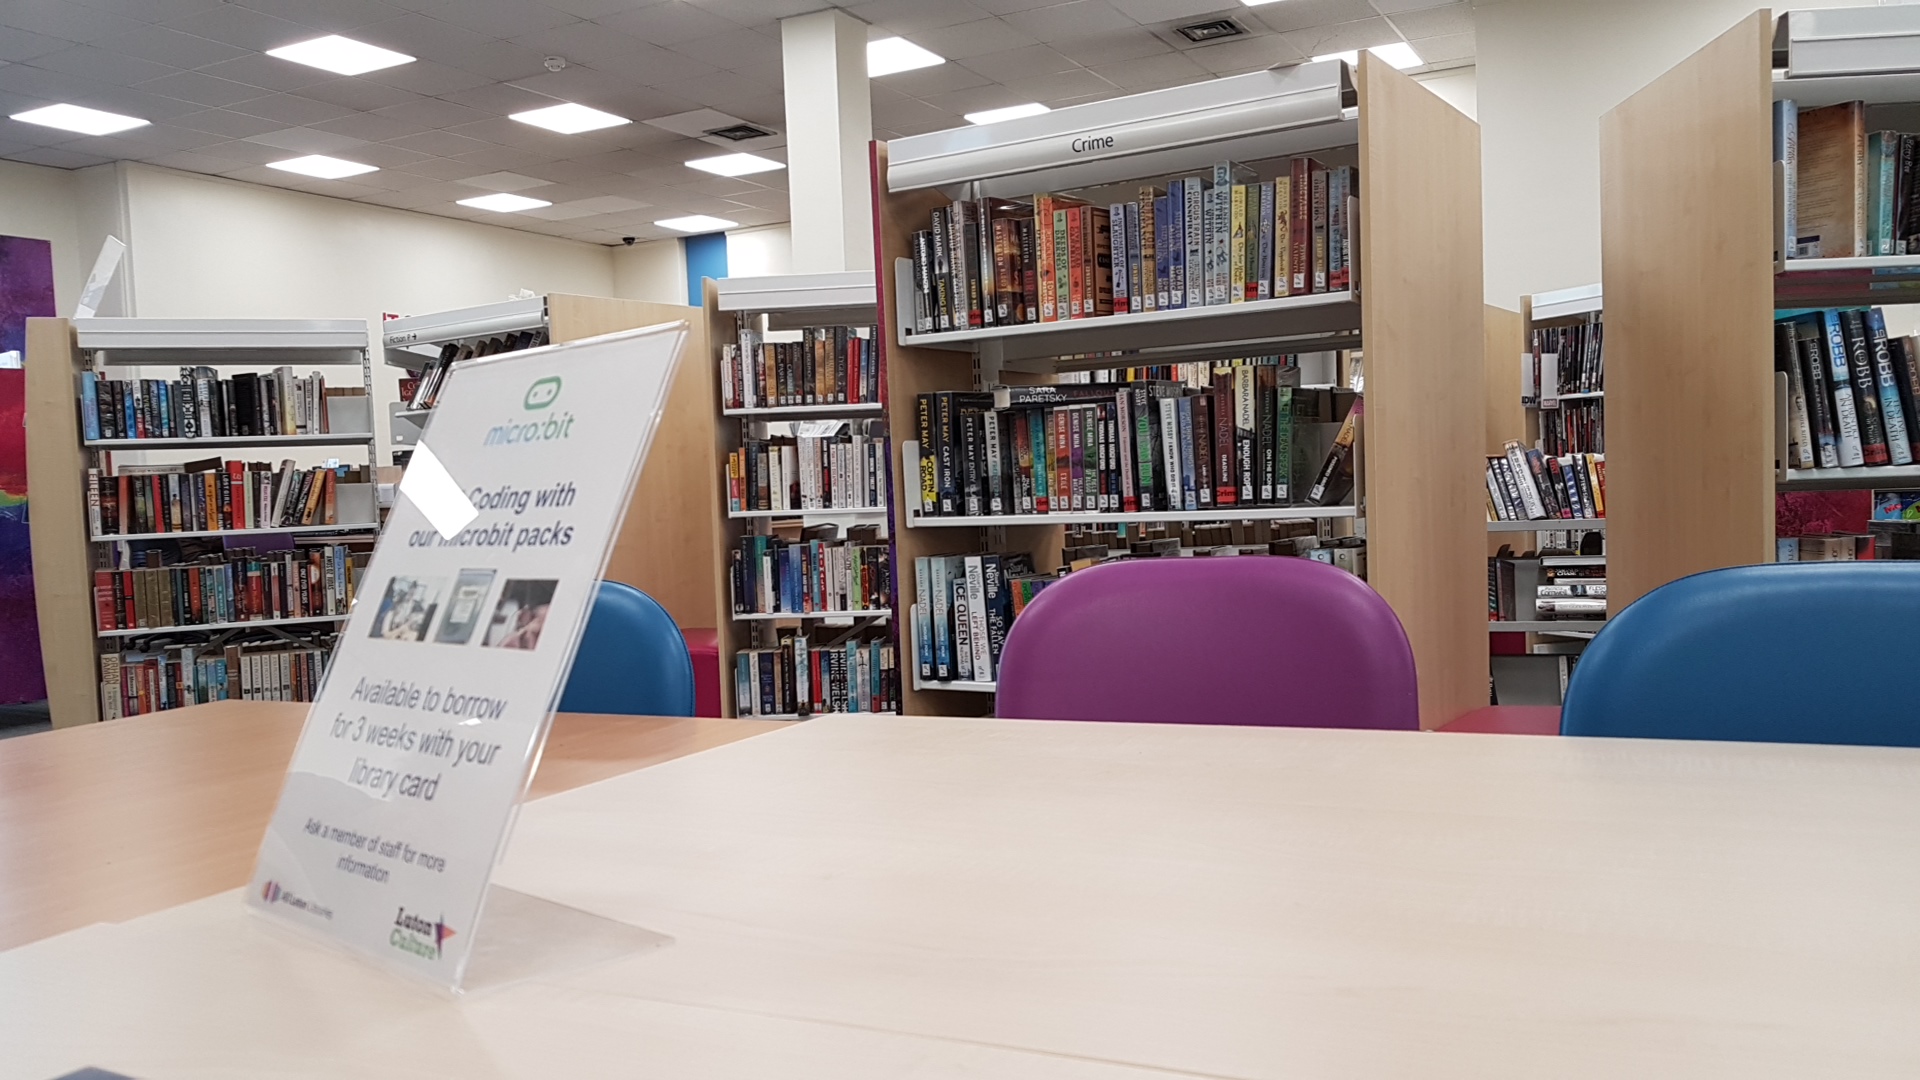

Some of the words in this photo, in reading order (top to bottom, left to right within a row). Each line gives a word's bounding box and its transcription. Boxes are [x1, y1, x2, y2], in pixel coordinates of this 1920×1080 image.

[1072, 136, 1114, 153] Crime
[1144, 190, 1153, 230] SIGNAL
[1299, 173, 1307, 220] TIMETABLE
[934, 212, 942, 233] DAVID
[1215, 191, 1223, 234] WITHIN
[935, 235, 943, 257] MARK
[995, 225, 1003, 266] MASTERTON
[1112, 219, 1120, 268] SLAUGHTER
[1146, 231, 1155, 249] FOR
[938, 278, 946, 306] TAKING
[389, 334, 407, 344] Fiction
[1830, 323, 1846, 368] ROBB
[1810, 349, 1822, 380] ROBB
[1851, 337, 1872, 389] ROBB
[1873, 336, 1895, 387] ROBB
[1028, 387, 1057, 395] SARA
[1148, 385, 1165, 398] STEVE
[1907, 361, 1920, 396] ROBB
[920, 399, 928, 428] PETER
[941, 397, 949, 423] PETER
[1019, 394, 1068, 404] PARETSKY
[1118, 393, 1126, 405] IAN
[1164, 403, 1173, 420] STEVE
[1521, 396, 1536, 405] IDW
[1839, 397, 1847, 406] IN
[1884, 397, 1892, 406] IN
[484, 411, 575, 447] micro:bit
[988, 416, 996, 441] PETER
[1138, 414, 1150, 437] YOU
[1242, 403, 1250, 426] NADEL
[1279, 416, 1289, 430] THE
[1841, 410, 1851, 438] DEATH
[1847, 392, 1857, 440] APPRENTICE
[1887, 410, 1900, 442] DEATH
[1894, 399, 1905, 436] FESTIVE
[966, 417, 974, 442] PETER
[1058, 434, 1066, 449] MINA
[1218, 417, 1229, 447] NADEL
[1262, 414, 1272, 446] NADEL
[1279, 432, 1289, 452] DEAD
[1198, 434, 1209, 460] NADEL
[1242, 439, 1251, 470] ENOUGH
[926, 460, 935, 493] COFFIN
[968, 462, 976, 483] ENTRY
[1141, 462, 1152, 487] RUN
[1279, 453, 1289, 477] SPEAK
[88, 473, 99, 507] EILEEN
[469, 485, 531, 515] Coding
[534, 481, 577, 508] with
[408, 528, 438, 548] our
[511, 520, 575, 552] packs
[955, 583, 966, 602] ICE
[967, 565, 980, 600] Neville
[985, 563, 997, 599] Neville
[918, 588, 928, 615] NADEL
[934, 589, 944, 616] NADEL
[989, 608, 997, 624] THE
[956, 603, 968, 646] QUEEN
[971, 611, 979, 630] LEFT
[978, 615, 986, 641] THOSE
[995, 616, 1003, 627] SO
[972, 632, 981, 661] BEHIND
[990, 626, 999, 655] FALLEN
[102, 657, 113, 686] PAMUK
[110, 656, 120, 685] ORHAN
[351, 676, 421, 710] Available
[421, 685, 441, 712] to
[442, 687, 508, 720] borrow
[831, 682, 841, 713] WELSH
[330, 712, 353, 739] for
[351, 715, 368, 742] 3
[366, 722, 417, 752] weeks
[418, 728, 454, 758] with
[451, 738, 503, 768] your
[348, 756, 399, 798] library
[399, 772, 442, 801] card
[303, 817, 322, 837] Ask
[321, 824, 330, 839] a
[329, 826, 368, 850] member
[367, 835, 381, 853] of
[379, 840, 404, 860] staff
[402, 843, 417, 864] for
[416, 852, 447, 874] more
[335, 855, 392, 884] information
[394, 905, 433, 937] Luton
[389, 927, 436, 961] Culture
